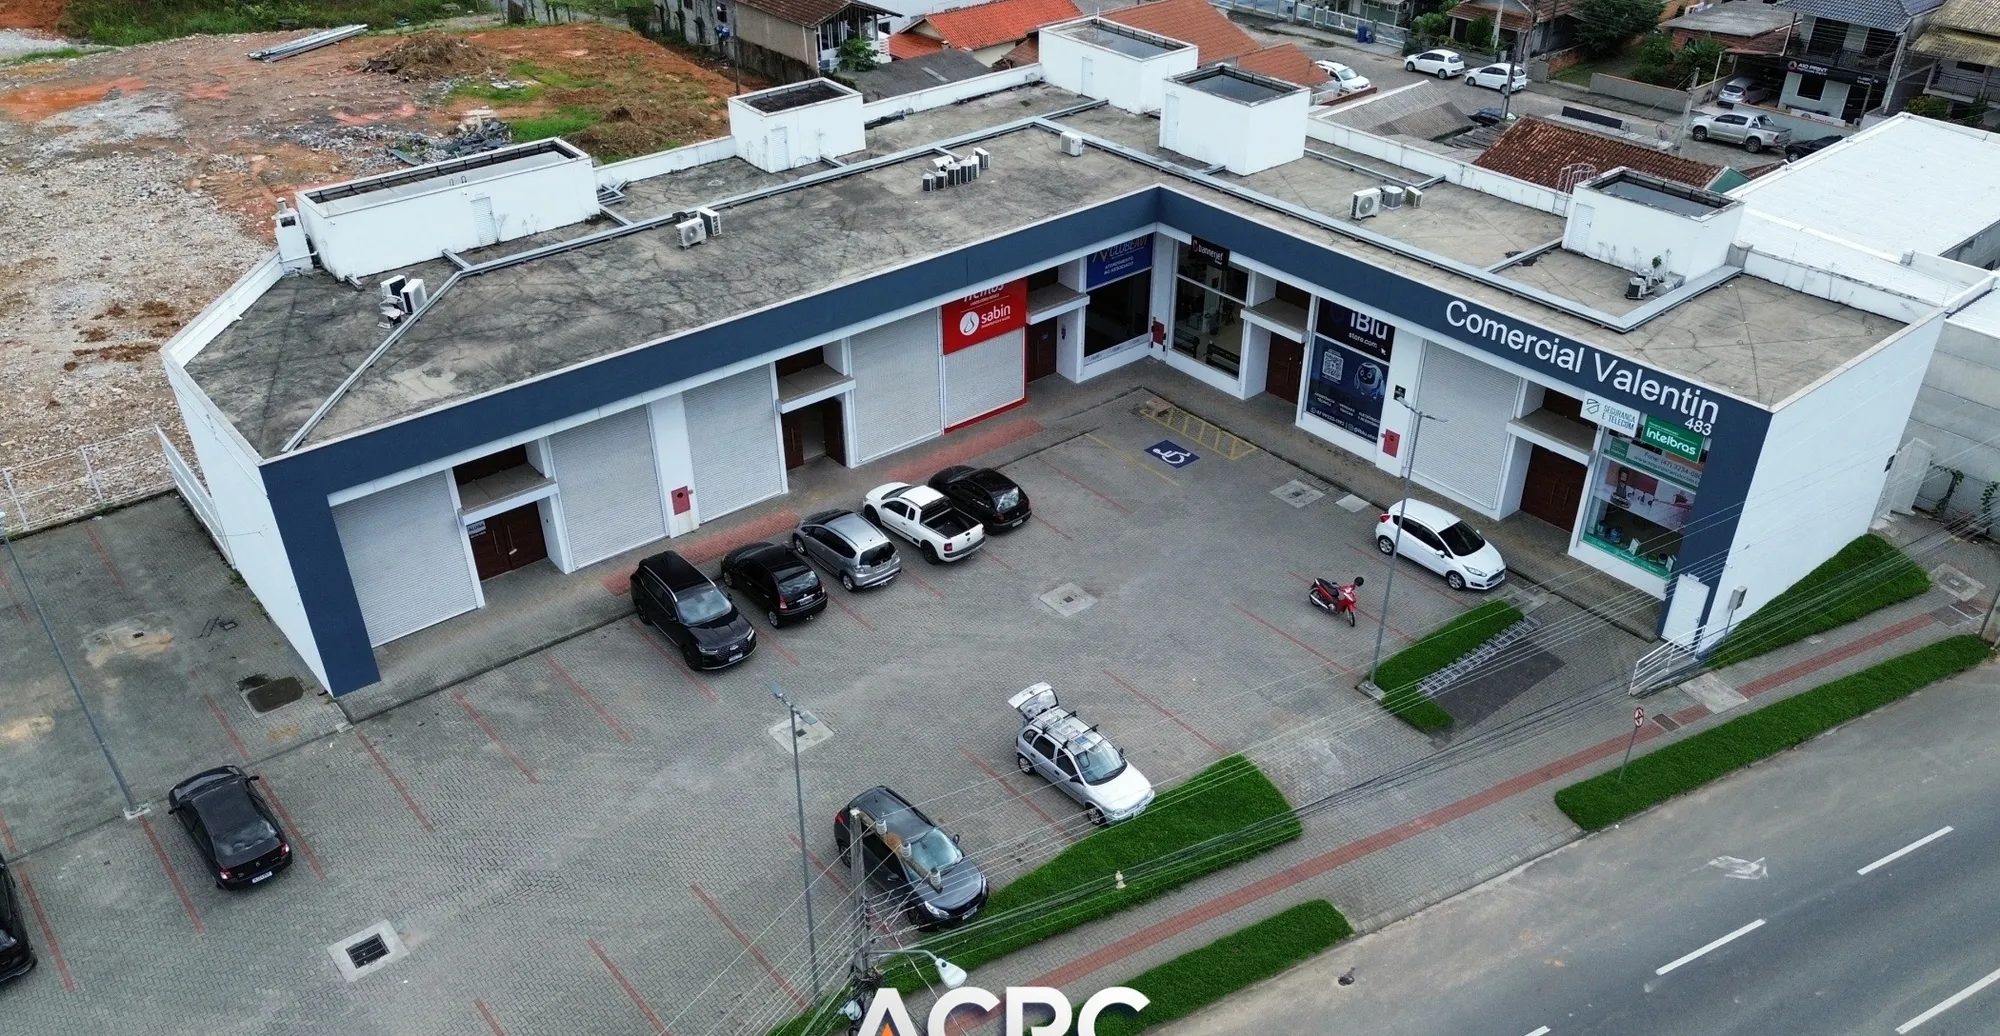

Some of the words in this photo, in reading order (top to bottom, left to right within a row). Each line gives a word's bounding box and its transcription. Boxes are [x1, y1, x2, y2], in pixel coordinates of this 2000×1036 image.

[981, 304, 1011, 325] sabin
[1446, 300, 1585, 373] Comercial
[1594, 353, 1719, 424] Valentin
[1608, 415, 1634, 430] TELECOM
[1685, 418, 1712, 436] 483
[1646, 427, 1696, 455] intelbras
